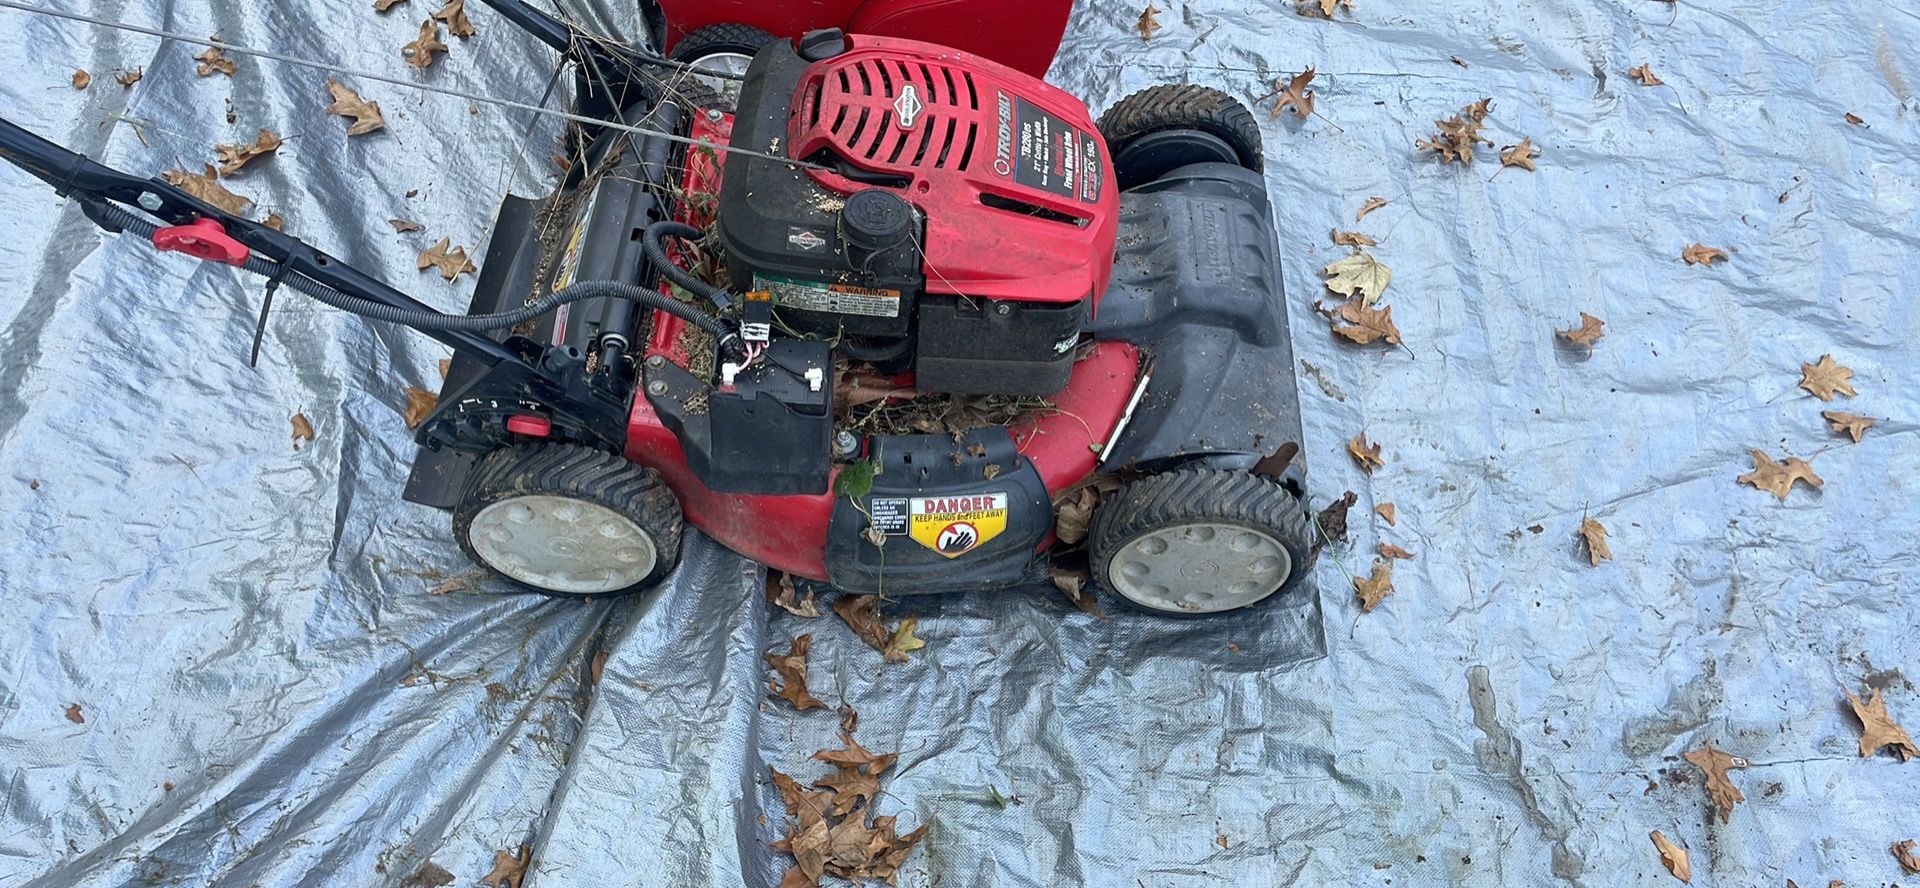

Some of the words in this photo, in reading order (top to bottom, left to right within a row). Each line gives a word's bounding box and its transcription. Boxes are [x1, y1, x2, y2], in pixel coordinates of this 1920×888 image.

[997, 91, 1011, 160] TROY-BILT
[1034, 121, 1042, 137] Width
[1064, 131, 1073, 148] Drive
[1034, 138, 1042, 161] Cutting
[1064, 148, 1073, 169] Wheel
[1063, 168, 1073, 189] Front
[845, 285, 889, 296] WARNING
[490, 400, 498, 408] 3
[924, 496, 994, 514] DANGER
[915, 514, 933, 523] KEEP
[933, 513, 956, 522] HANDS
[957, 512, 969, 521] and
[969, 512, 985, 520] FEET
[985, 510, 1005, 519] AWAY
